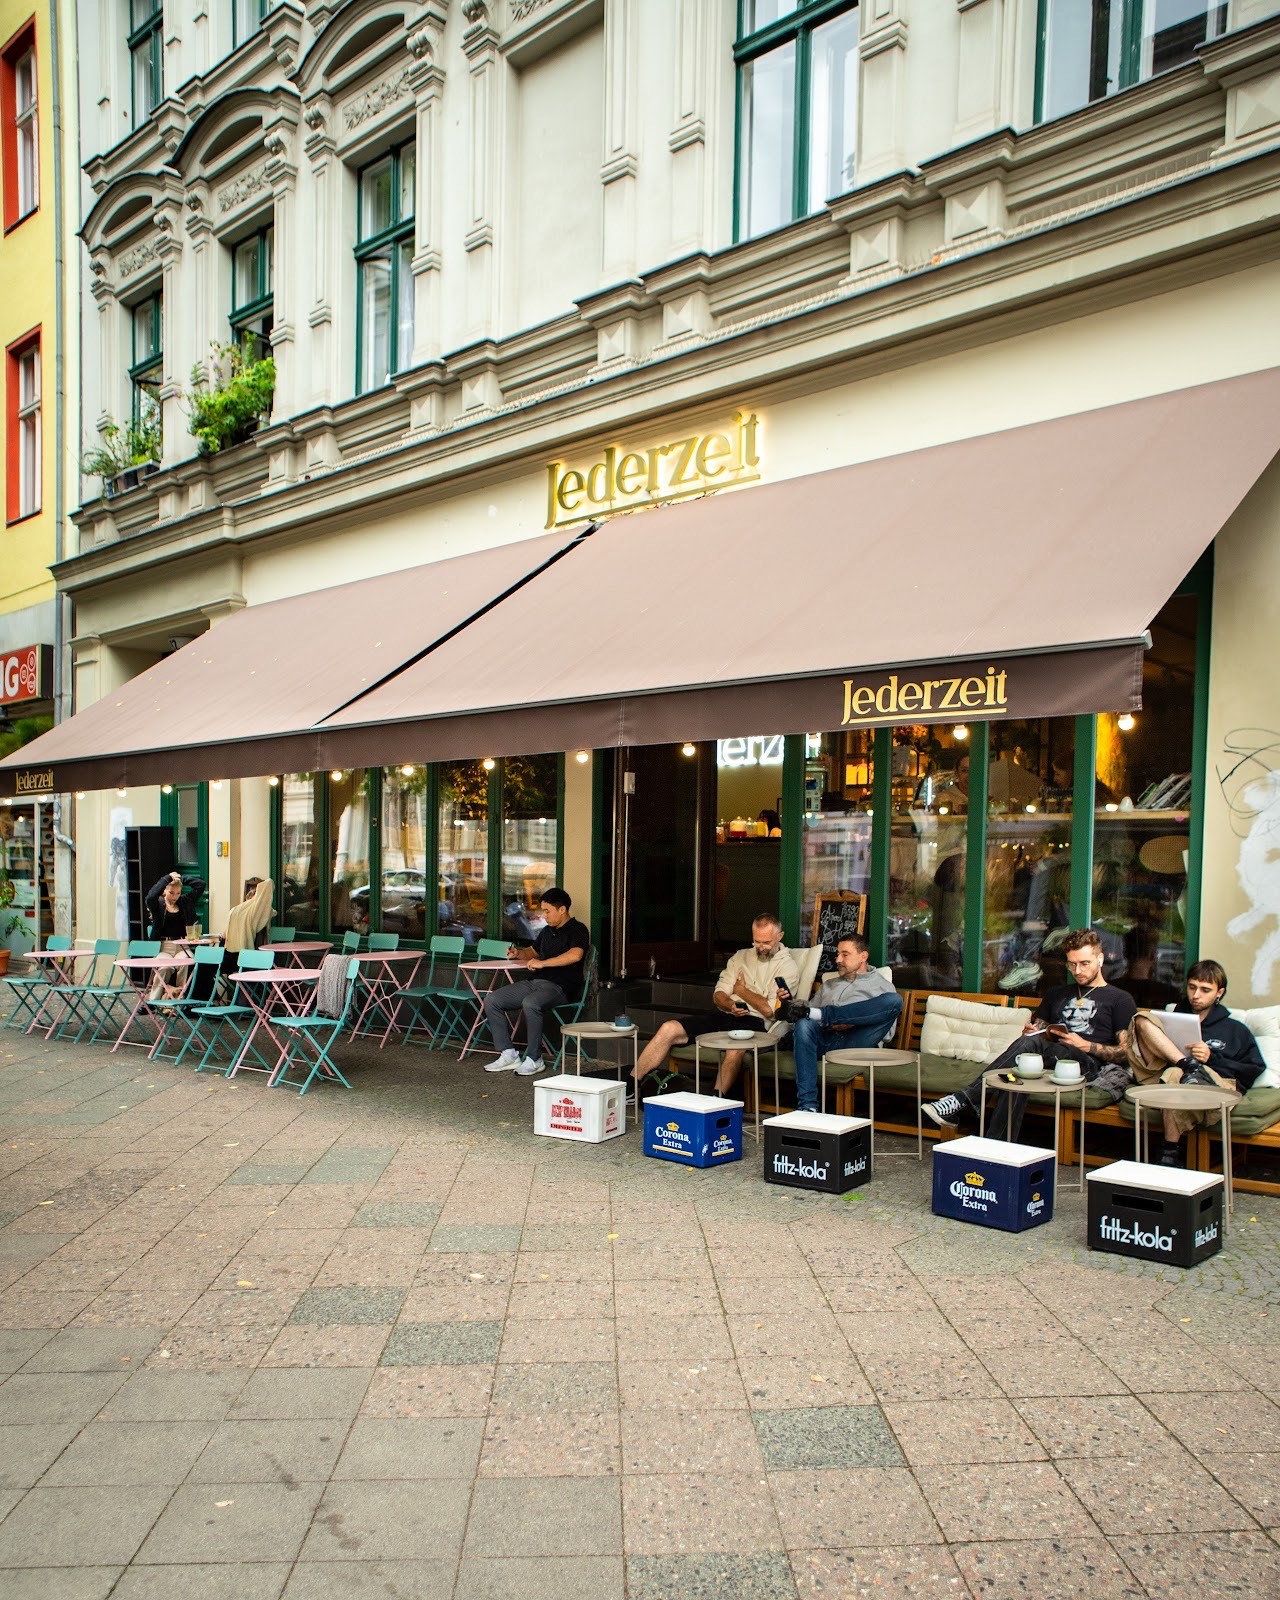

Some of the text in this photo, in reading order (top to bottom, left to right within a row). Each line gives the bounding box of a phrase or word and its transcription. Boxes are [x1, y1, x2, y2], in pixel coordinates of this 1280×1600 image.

[544, 411, 760, 529] Jederzeit
[0, 656, 19, 698] G
[841, 666, 1008, 725] Jederzeit
[16, 769, 53, 794] Jederzeit
[655, 1126, 690, 1142] Corona
[662, 1138, 682, 1149] Extra
[949, 1180, 996, 1203] Corona
[962, 1196, 988, 1212] Extra
